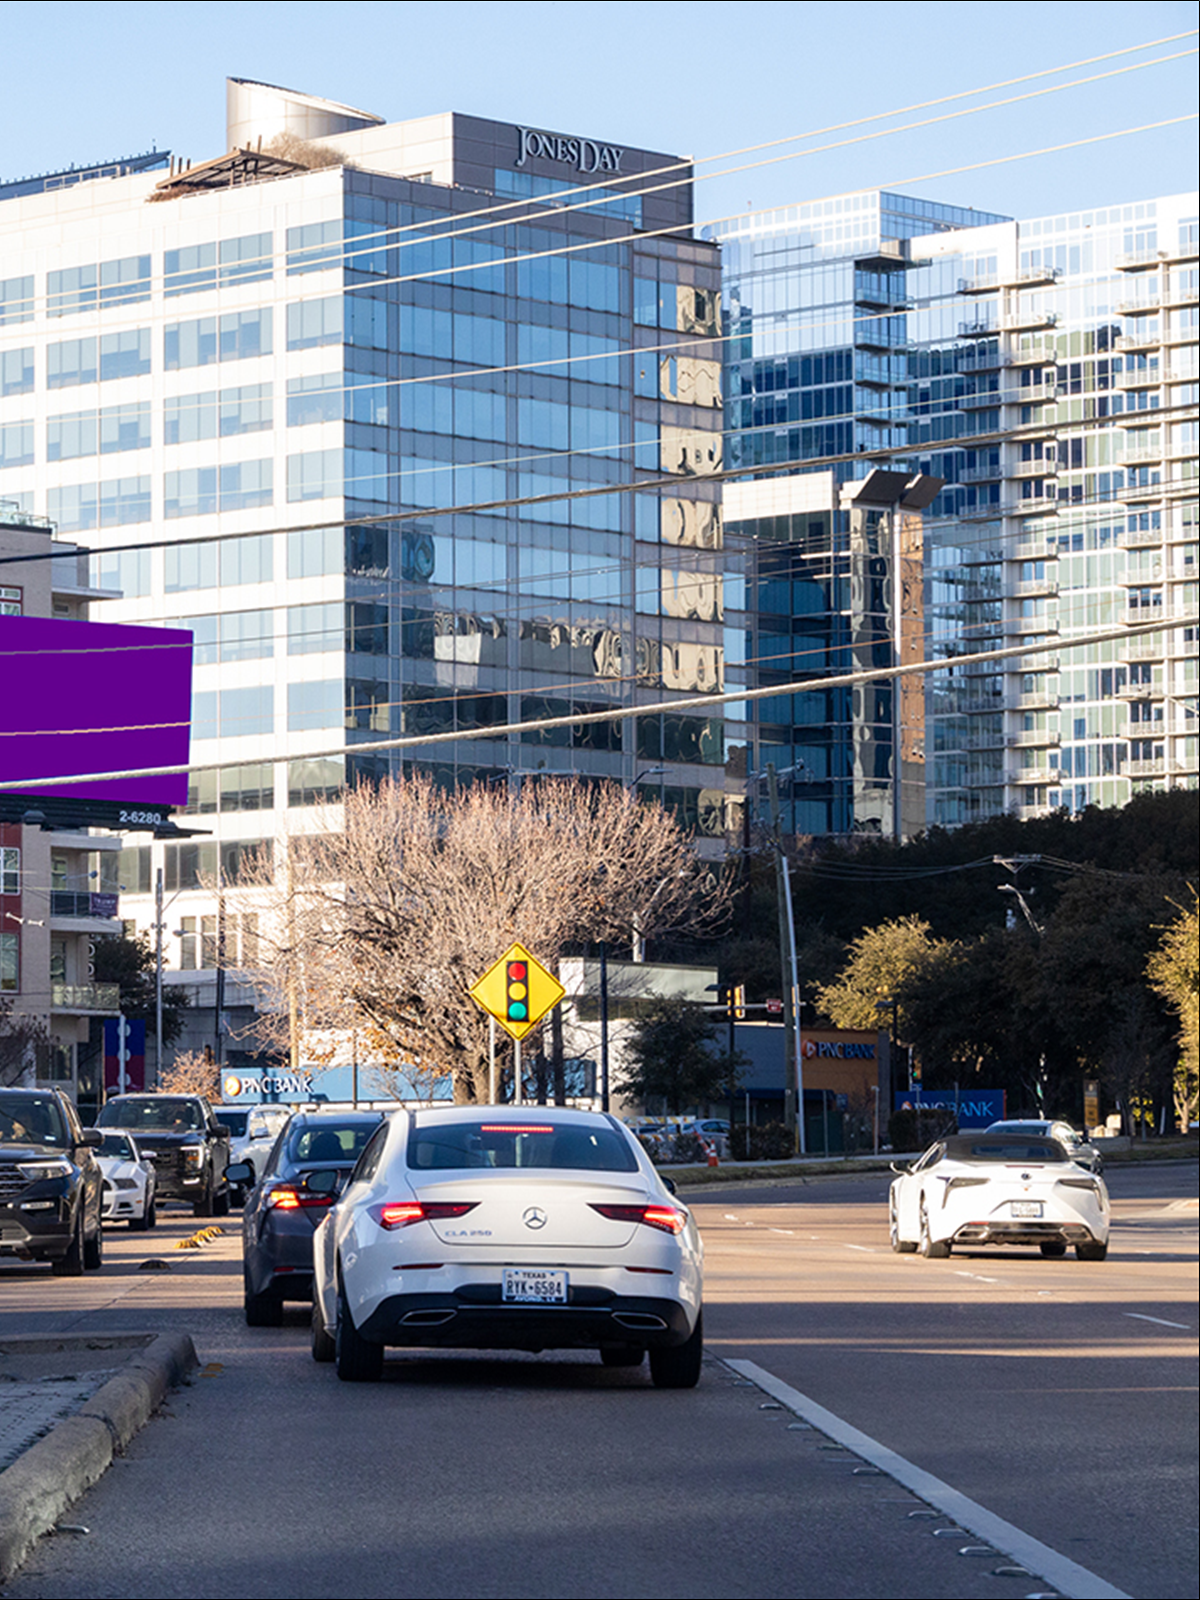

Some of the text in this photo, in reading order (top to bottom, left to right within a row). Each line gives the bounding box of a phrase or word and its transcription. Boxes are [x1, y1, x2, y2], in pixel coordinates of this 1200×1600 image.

[119, 810, 161, 825] 2-6280
[818, 1042, 876, 1059] PNC BANK
[241, 1076, 314, 1094] PNC BANK
